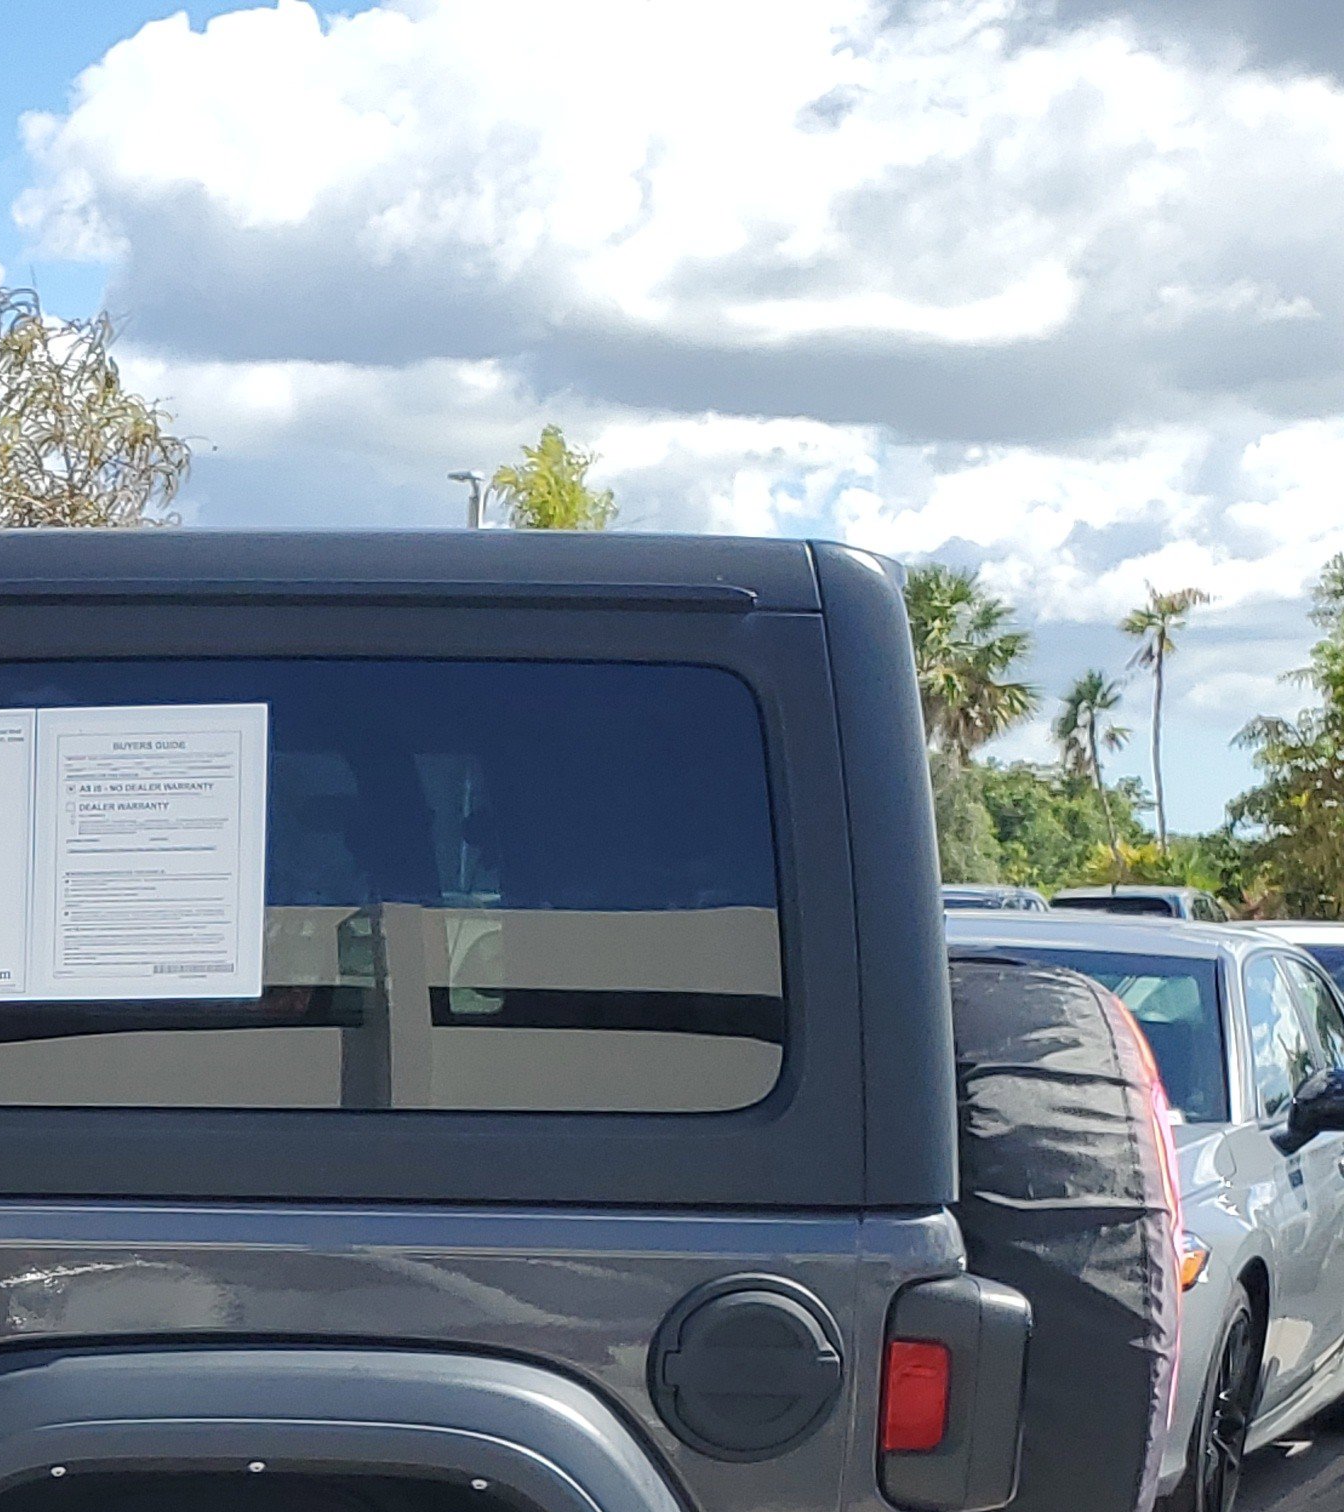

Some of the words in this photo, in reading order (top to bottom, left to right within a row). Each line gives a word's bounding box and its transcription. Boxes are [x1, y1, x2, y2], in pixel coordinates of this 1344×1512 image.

[113, 741, 152, 751] BUYERS
[155, 741, 186, 750] GUIDE
[79, 784, 91, 793] AS
[109, 784, 123, 793] NO
[125, 783, 162, 792] DEALER
[163, 782, 214, 791] WARRANTY
[79, 802, 116, 812] DEALER
[117, 802, 169, 811] WARRANTY
